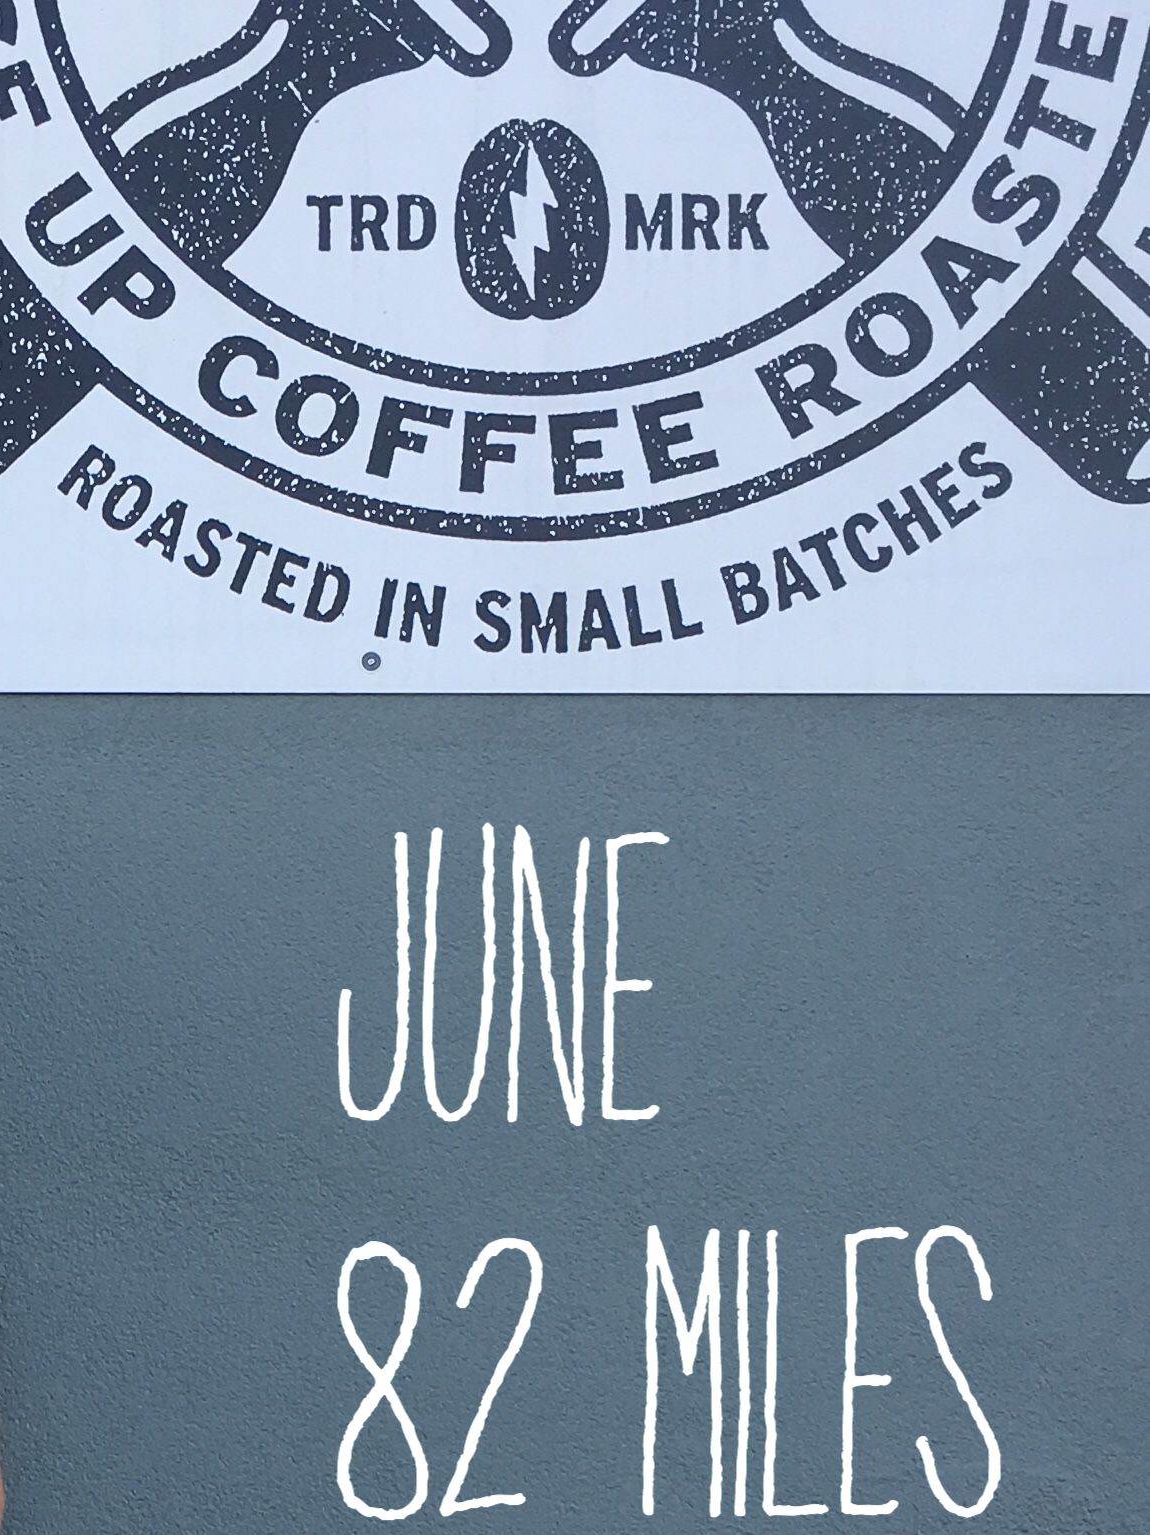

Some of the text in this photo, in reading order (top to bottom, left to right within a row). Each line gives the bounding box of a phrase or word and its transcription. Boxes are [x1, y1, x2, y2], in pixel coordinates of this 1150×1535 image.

[24, 171, 176, 320] UP
[198, 335, 720, 496] COFFEE
[754, 0, 1129, 440] ROASTE
[306, 192, 770, 252] TRD MRK
[57, 441, 1013, 654] ROASTED IN SMALL BATCHES
